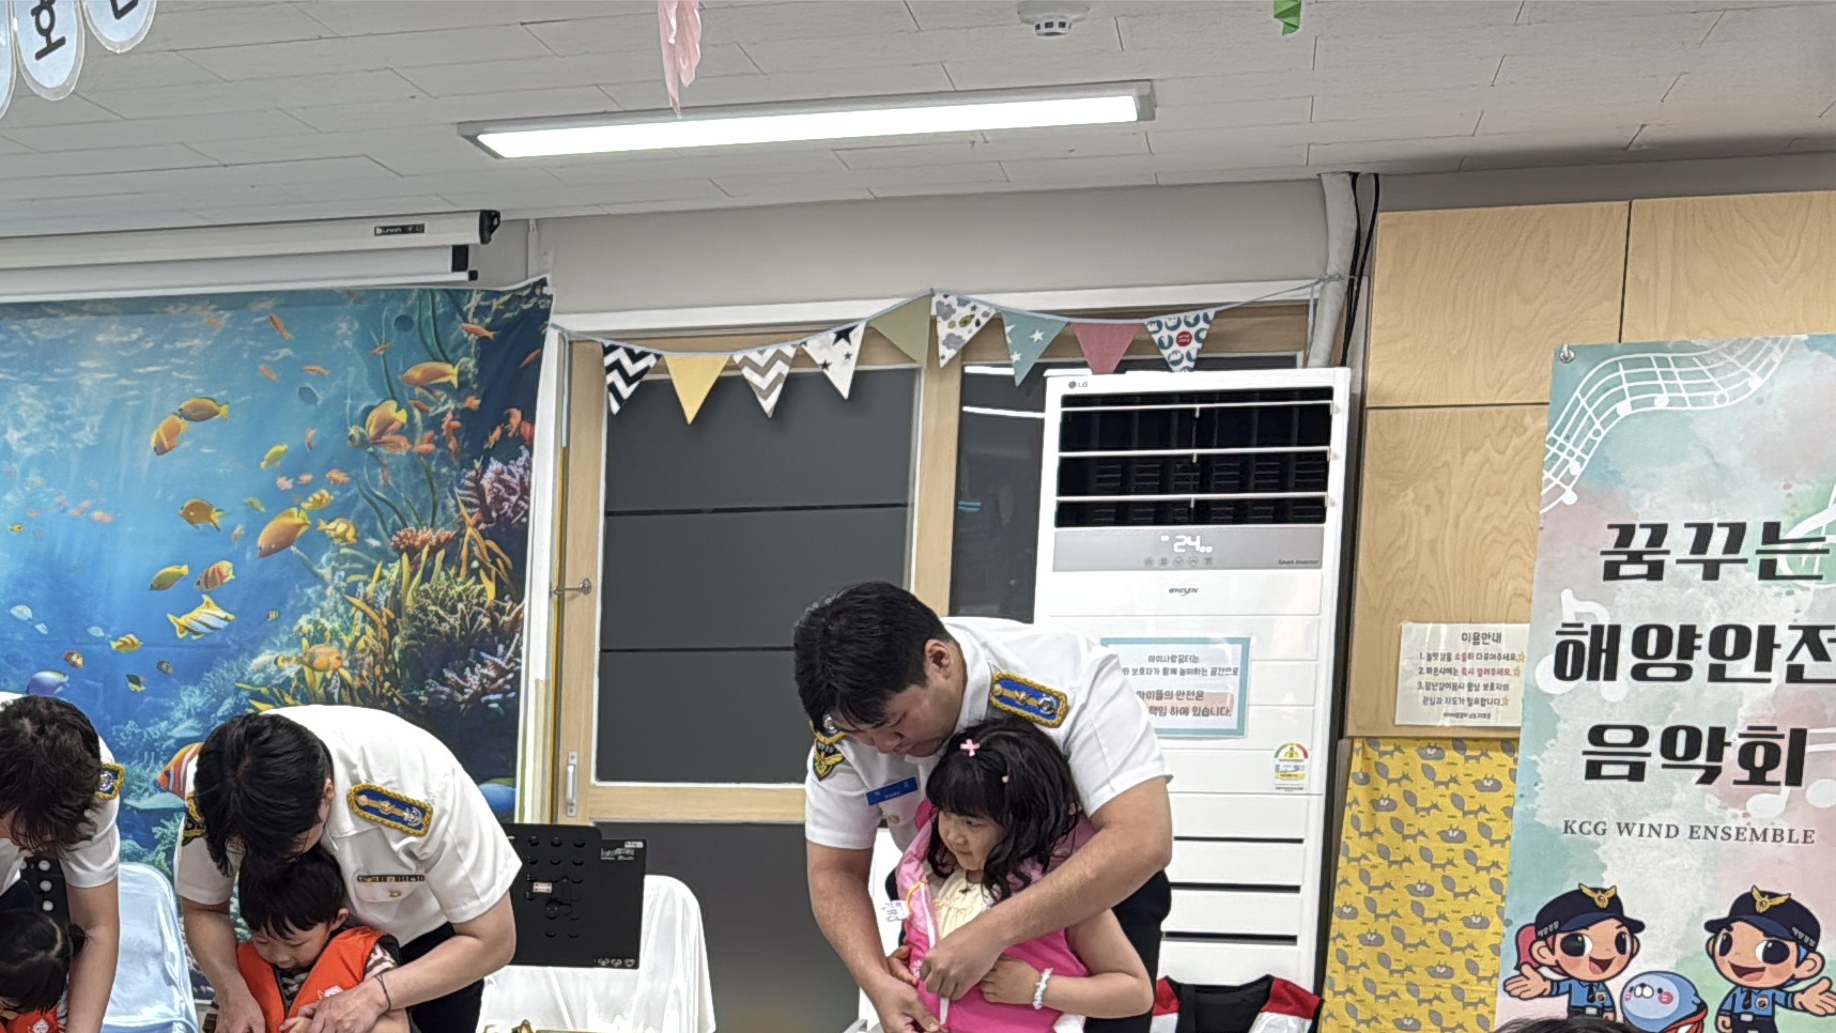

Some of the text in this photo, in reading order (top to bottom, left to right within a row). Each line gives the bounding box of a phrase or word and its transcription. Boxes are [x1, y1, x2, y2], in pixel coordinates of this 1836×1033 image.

[1599, 521, 1830, 582] 꿈꾸는
[1461, 631, 1502, 646] 이용안내
[1553, 622, 1836, 684] 해양안전
[1175, 690, 1205, 701] 안전은
[1581, 724, 1809, 788] 음악회
[1562, 819, 1816, 845] KCG WIND ENSEMBLE
